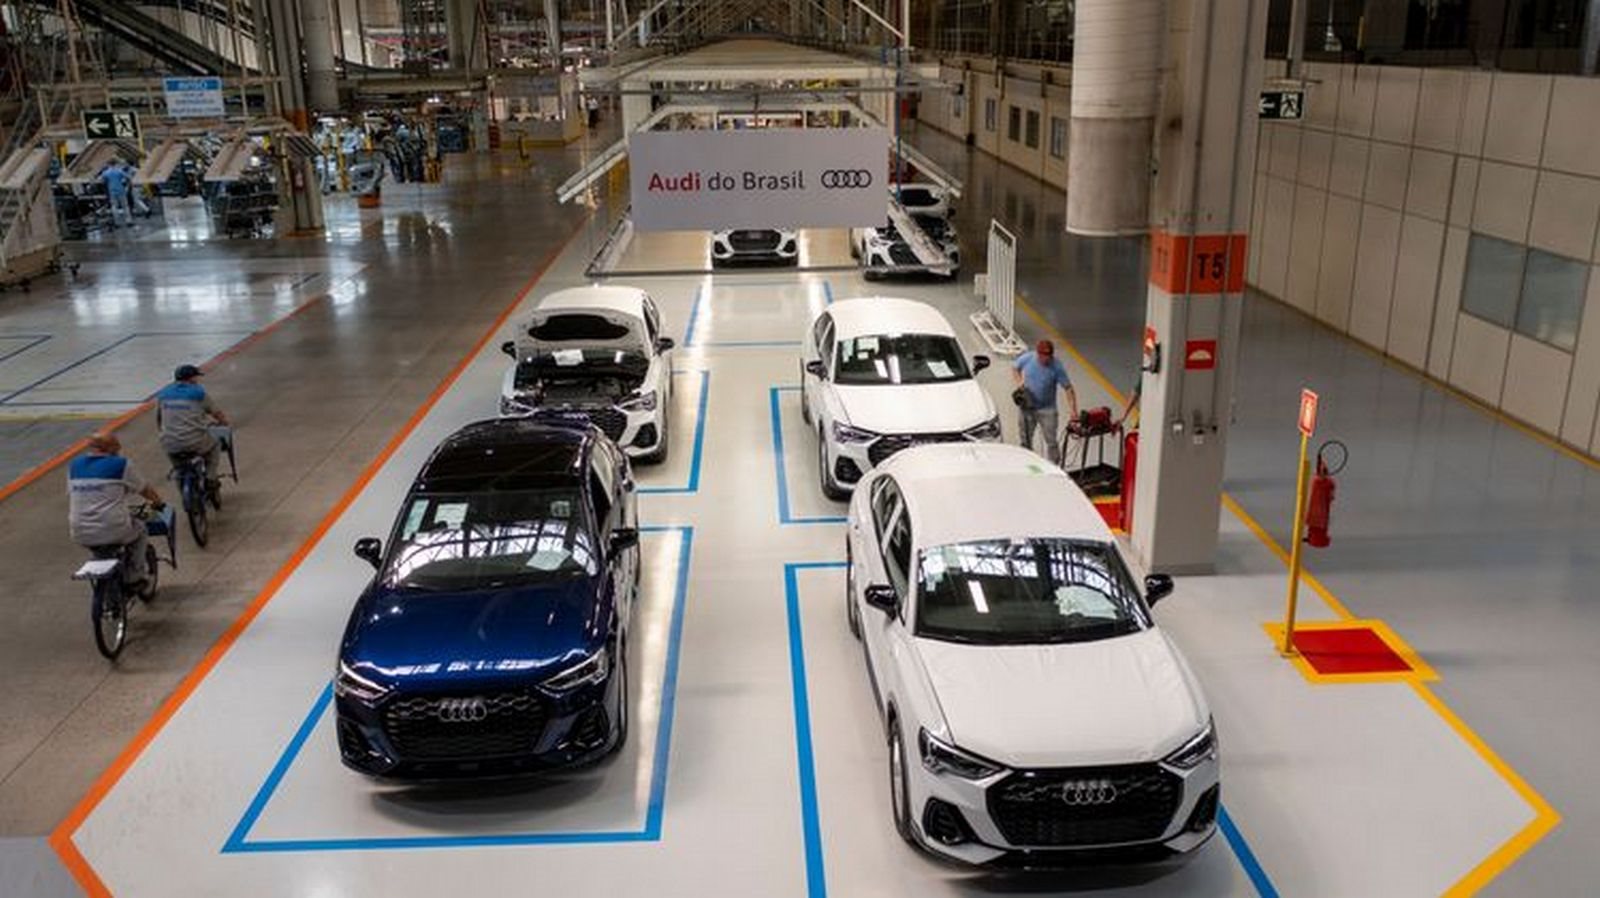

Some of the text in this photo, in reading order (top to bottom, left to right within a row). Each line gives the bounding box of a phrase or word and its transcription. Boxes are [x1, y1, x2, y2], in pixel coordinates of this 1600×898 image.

[648, 170, 806, 192] Audi do Brasil
[1197, 253, 1224, 279] T5
